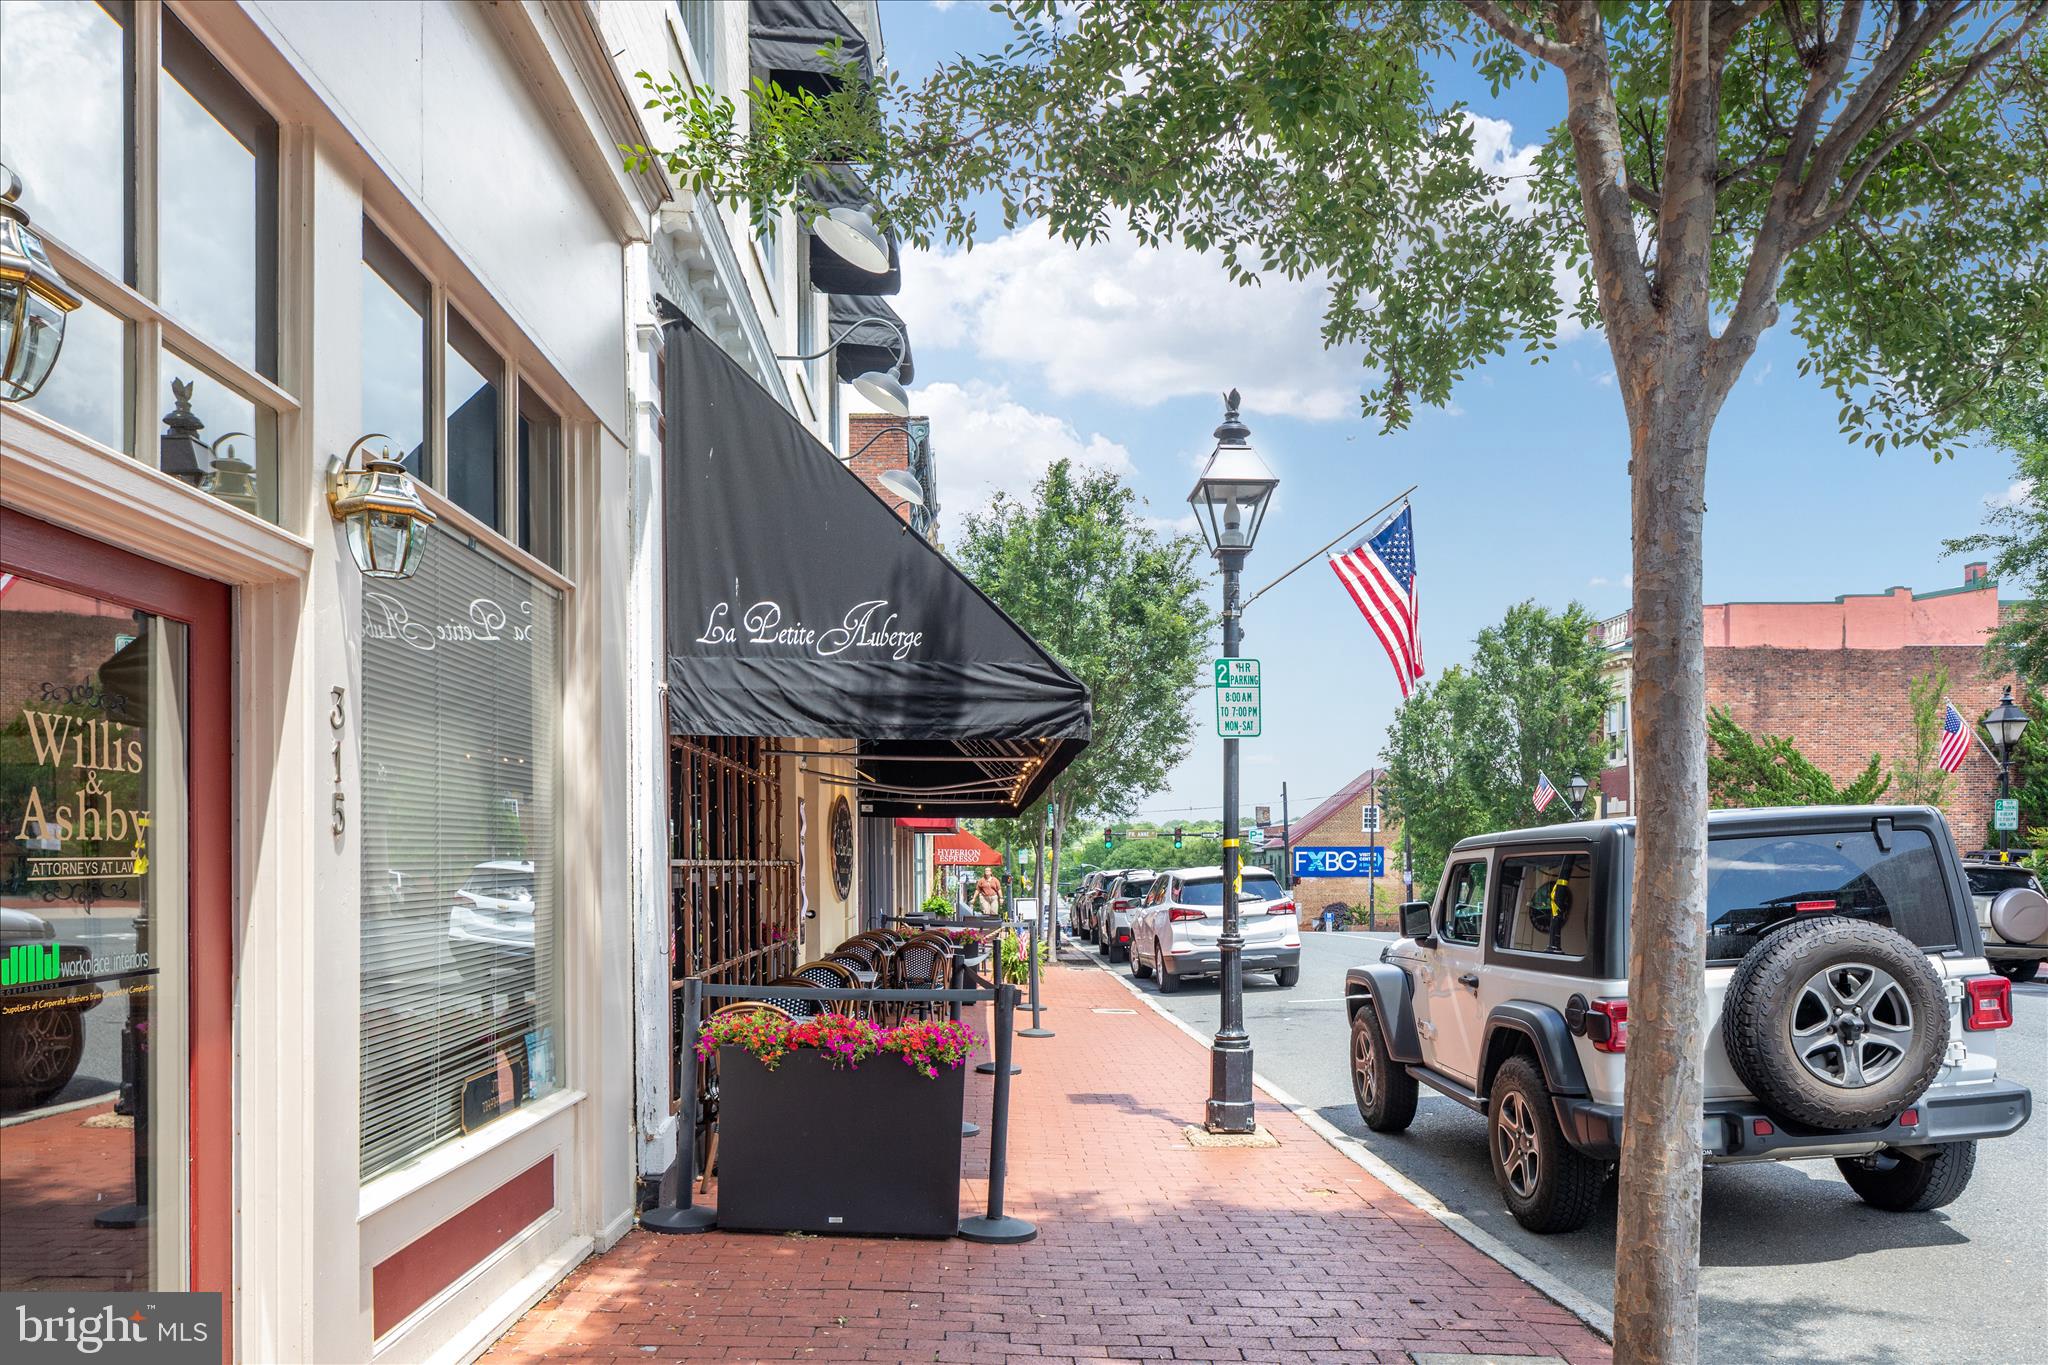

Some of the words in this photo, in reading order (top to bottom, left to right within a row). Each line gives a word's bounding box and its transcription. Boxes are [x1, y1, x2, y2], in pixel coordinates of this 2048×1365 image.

[696, 602, 736, 643] La
[744, 601, 815, 645] Petite
[816, 600, 923, 660] Auberge
[1217, 664, 1228, 683] 2
[1238, 663, 1251, 673] HR
[1230, 675, 1259, 685] PARKING
[1225, 692, 1241, 702] 8:00
[1242, 692, 1252, 702] AM
[1220, 706, 1229, 717] TO
[1231, 706, 1247, 717] 7:00
[1248, 706, 1258, 717] PM
[23, 709, 143, 774] Willis
[86, 770, 104, 795] &
[1997, 801, 2003, 810] 2
[15, 786, 150, 858] Ashby
[1250, 831, 1257, 840] P
[937, 849, 981, 857] HYPERION
[1295, 851, 1358, 872] FXBG
[32, 862, 98, 876] ATTORNEYS
[101, 861, 114, 875] AT
[61, 955, 110, 980] workplace
[113, 951, 149, 971] interiors
[2, 1004, 31, 1014] Suppliers
[32, 1001, 39, 1010] of
[39, 998, 66, 1008] Corporate
[67, 994, 89, 1004] Interiors
[90, 992, 102, 1000] from
